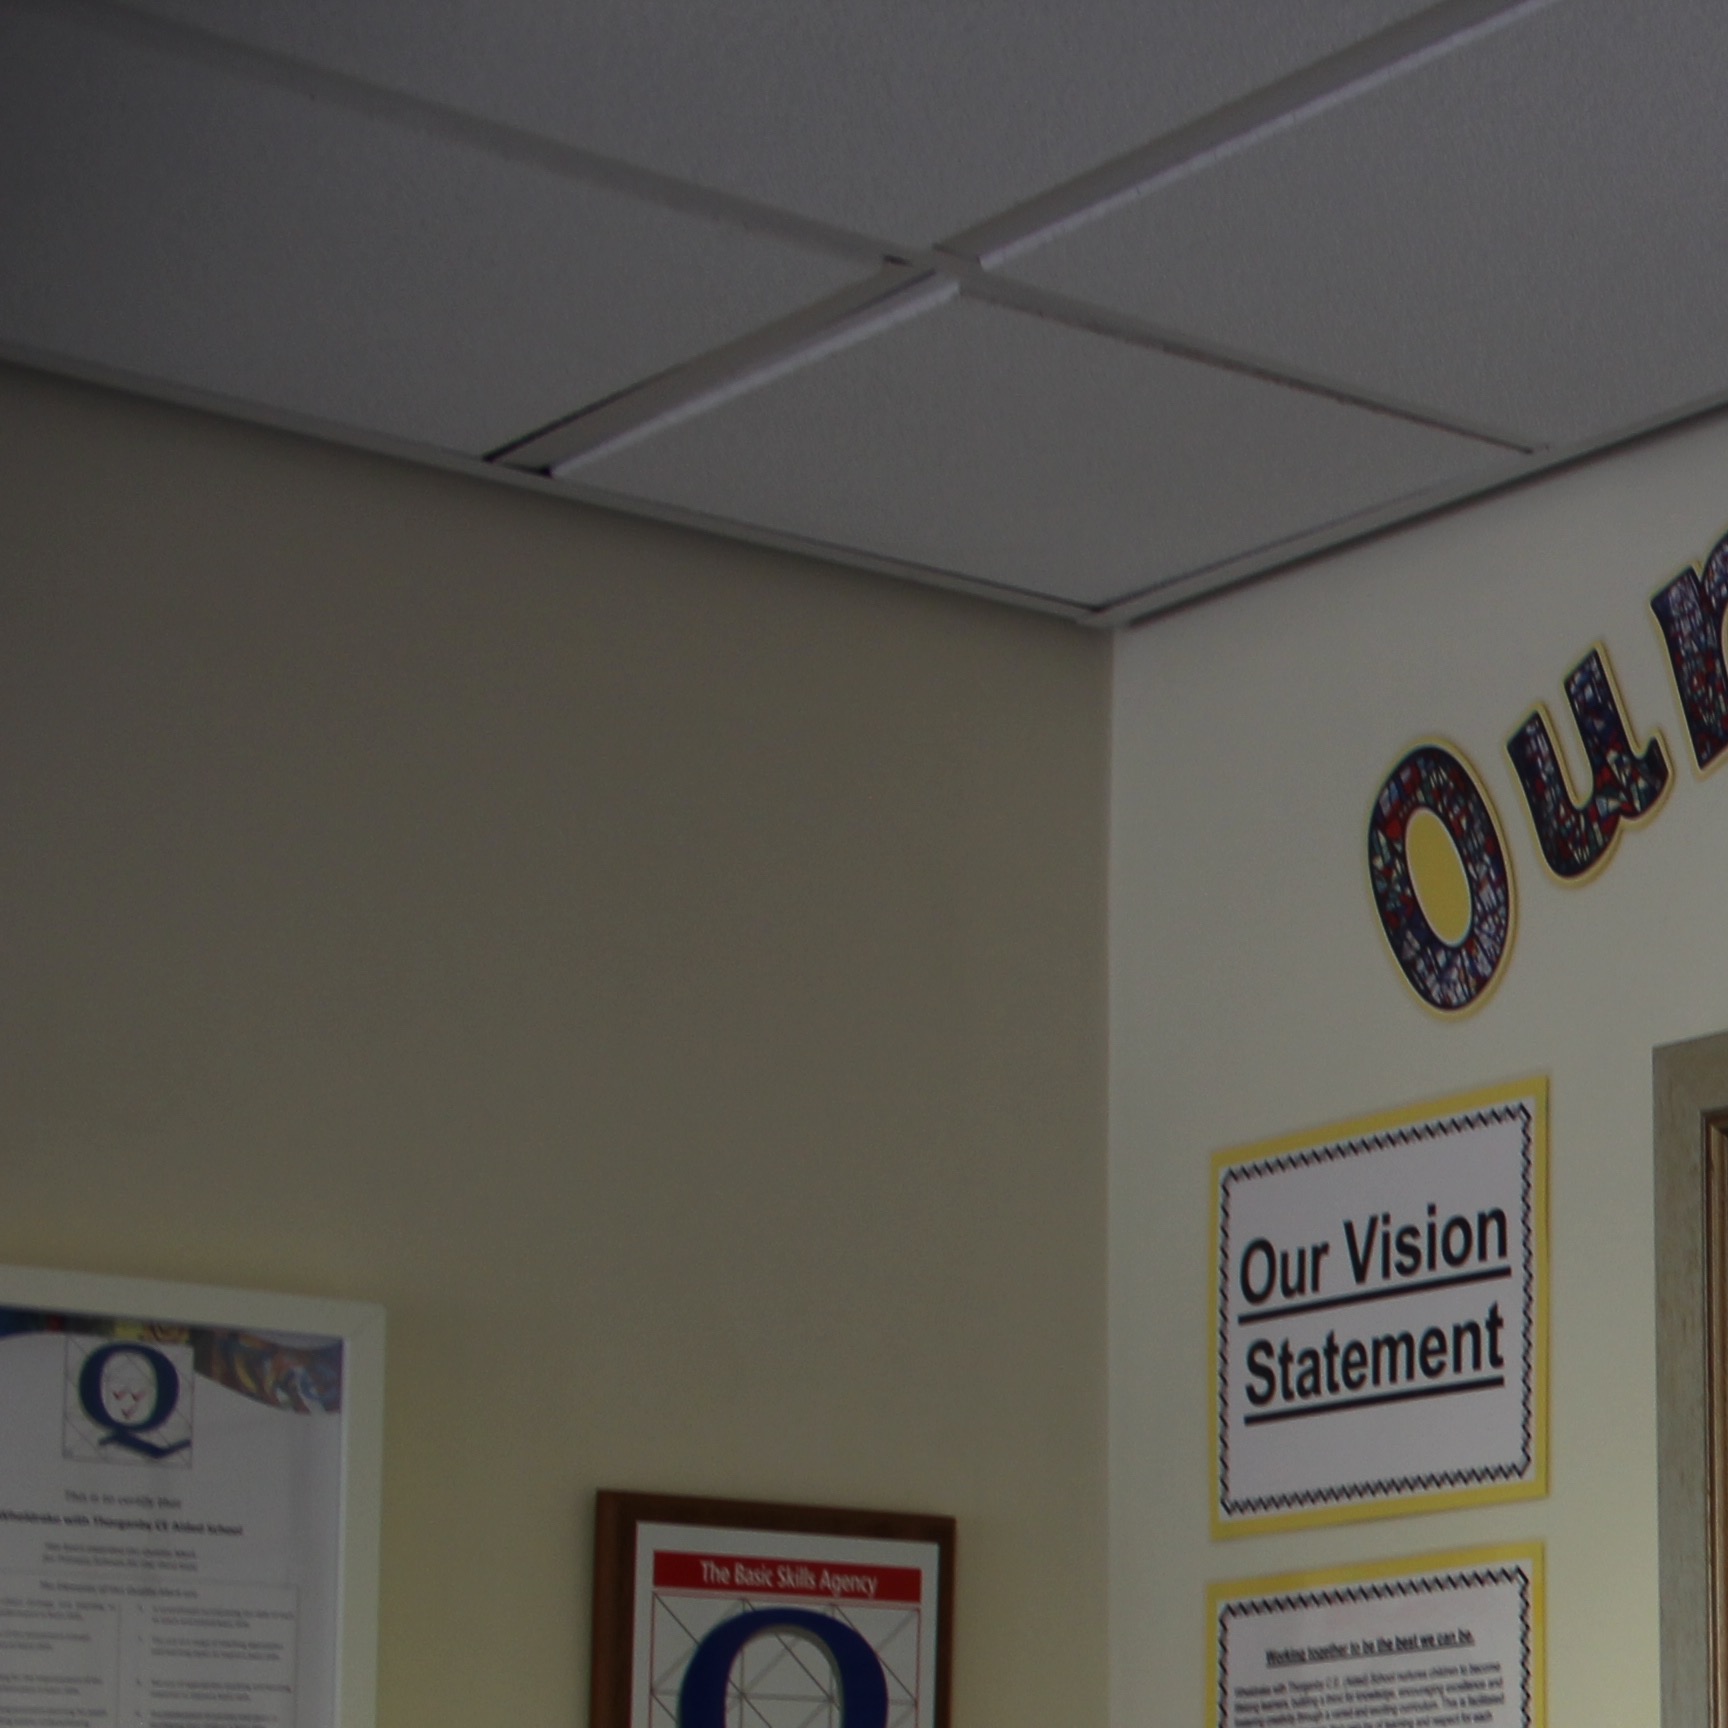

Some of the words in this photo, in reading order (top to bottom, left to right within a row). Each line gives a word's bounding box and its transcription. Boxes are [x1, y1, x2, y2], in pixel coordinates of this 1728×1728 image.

[1239, 1236, 1330, 1305] Our
[1343, 1202, 1508, 1285] Vision
[1245, 1301, 1504, 1407] Statement
[700, 1559, 731, 1585] The
[734, 1561, 774, 1588] Basic
[776, 1563, 817, 1591] Skills
[820, 1567, 879, 1599] Agency
